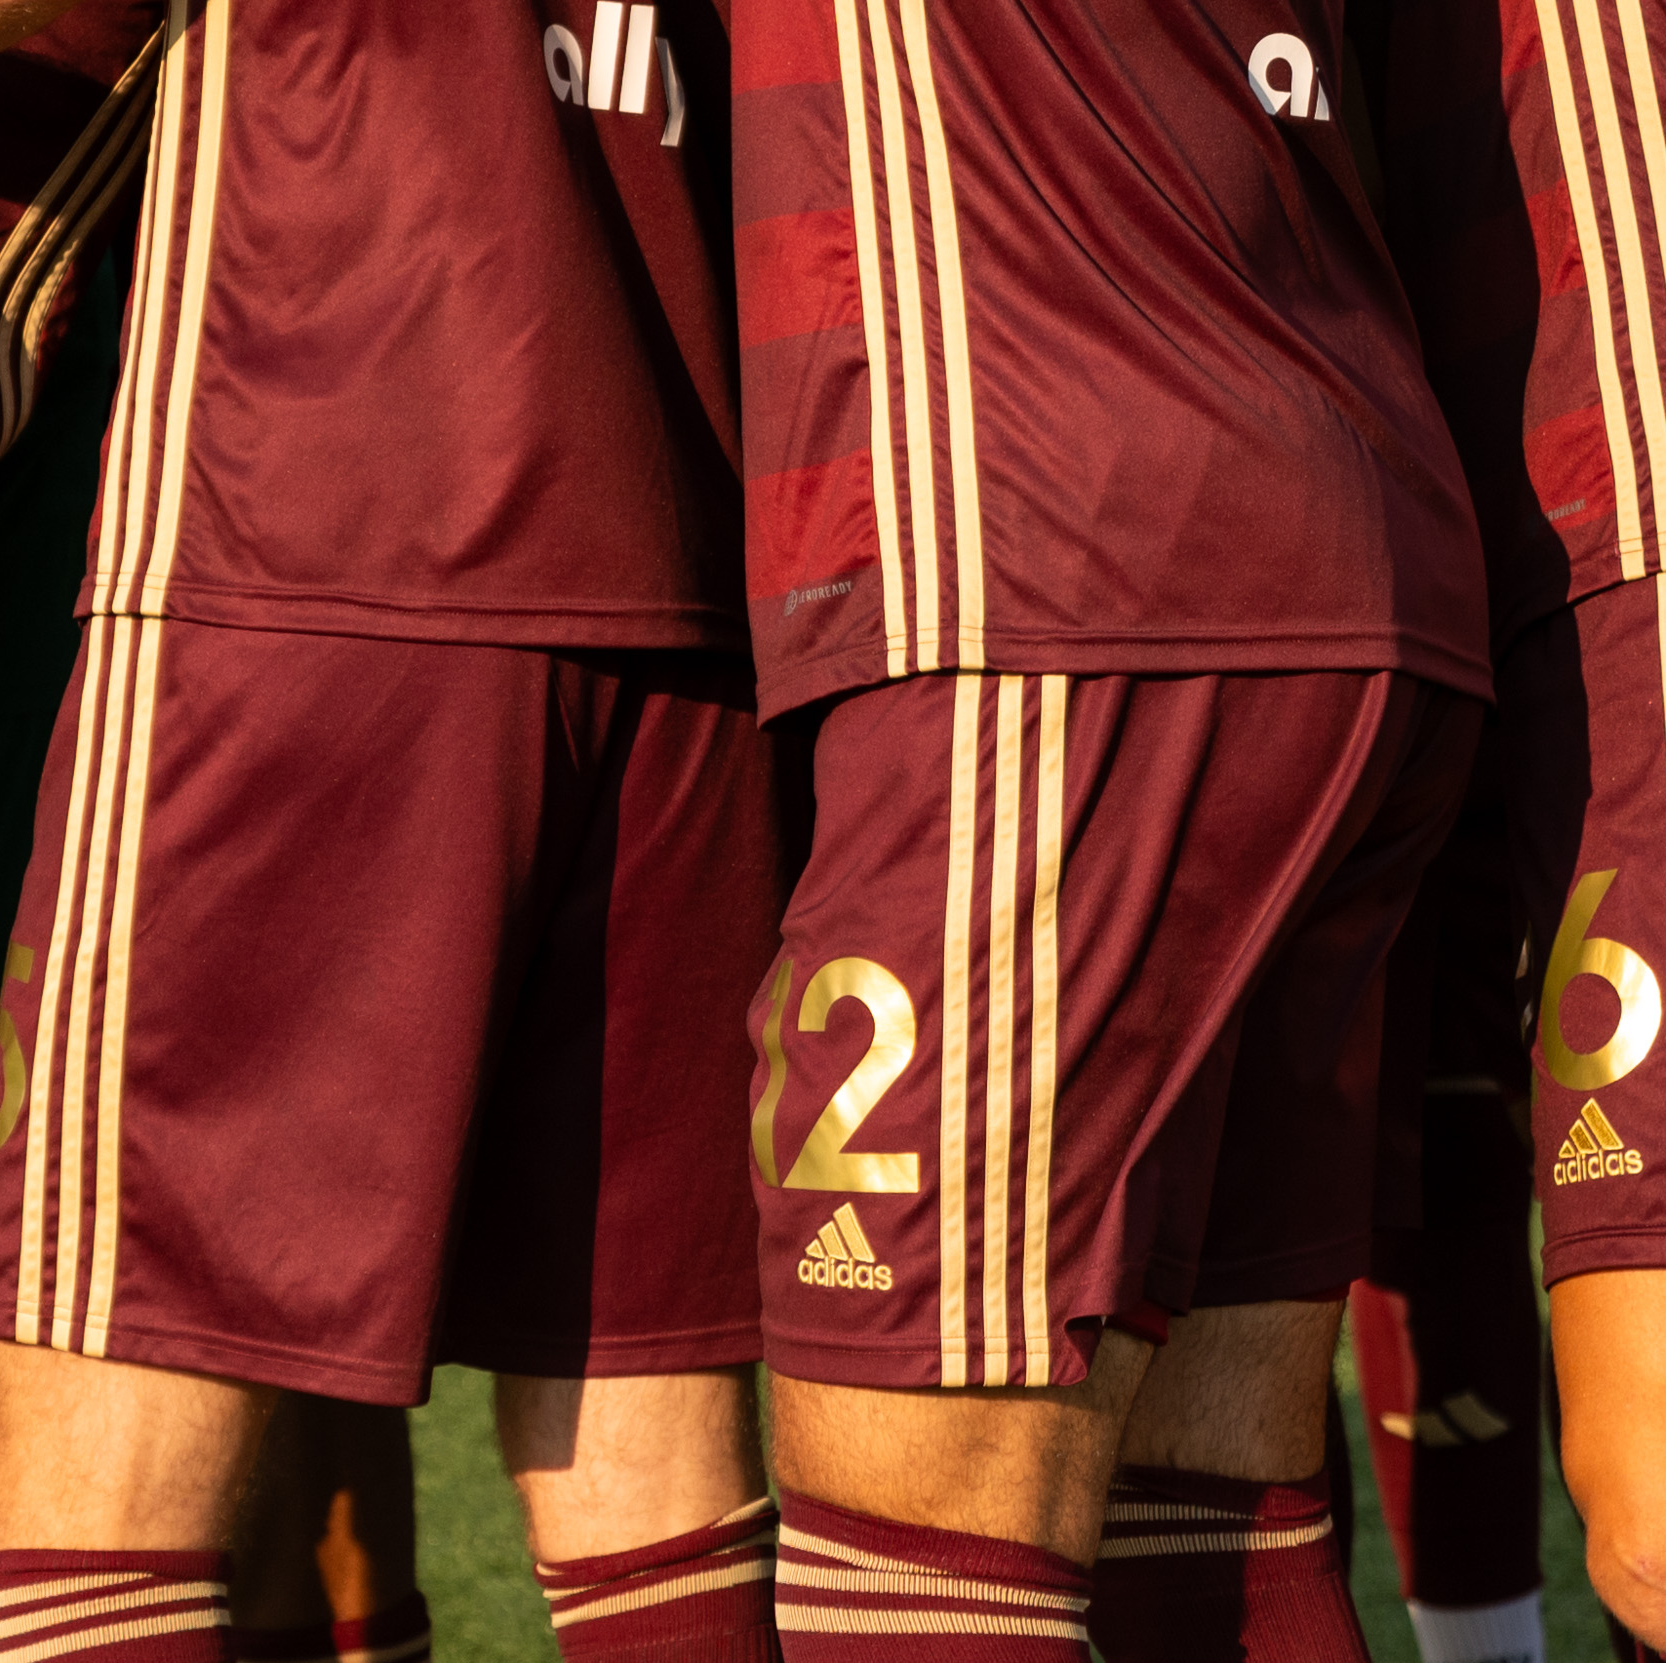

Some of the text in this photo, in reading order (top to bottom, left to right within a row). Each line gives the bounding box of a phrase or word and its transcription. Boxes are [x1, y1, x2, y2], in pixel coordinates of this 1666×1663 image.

[543, 0, 685, 147] ally
[1540, 868, 1662, 1091] 6
[751, 957, 919, 1194] 12
[1554, 1149, 1643, 1185] adidas
[797, 1256, 893, 1291] adidas
